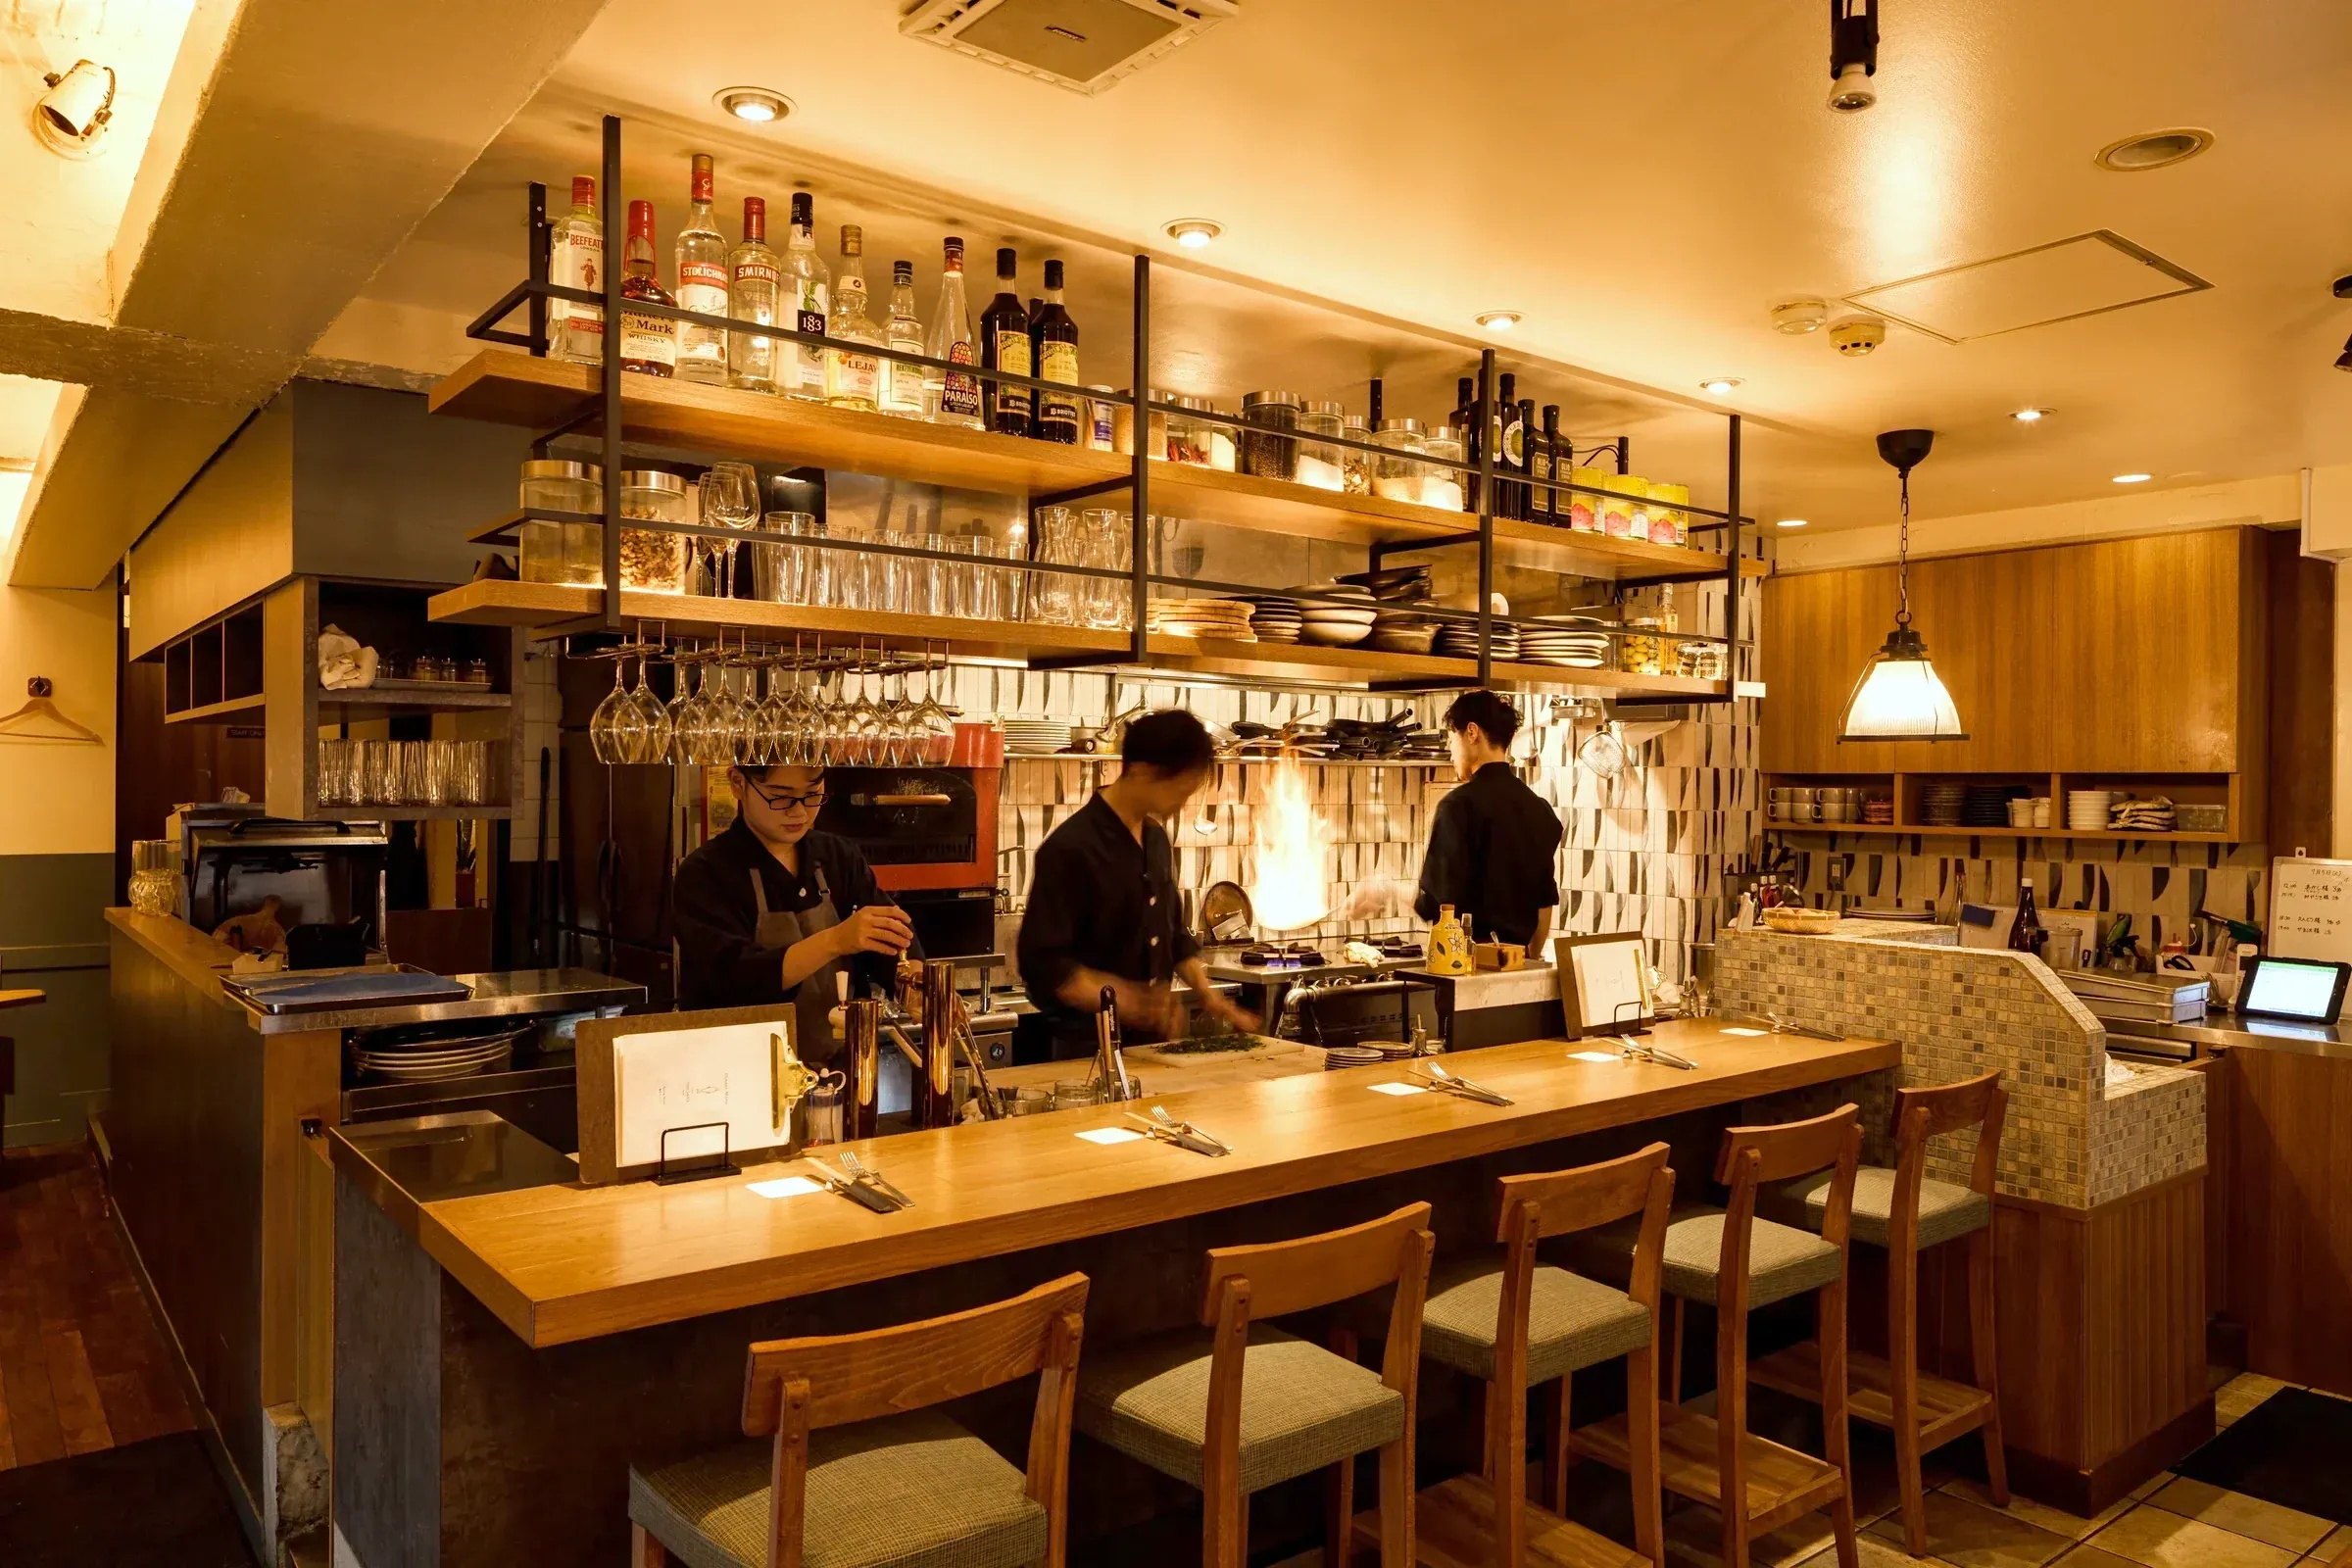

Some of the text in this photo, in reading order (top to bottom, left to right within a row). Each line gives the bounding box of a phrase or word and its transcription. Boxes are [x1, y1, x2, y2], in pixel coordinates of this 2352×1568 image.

[635, 319, 674, 334] Mark
[628, 333, 665, 343] WHISKY
[849, 360, 877, 373] LEJAY
